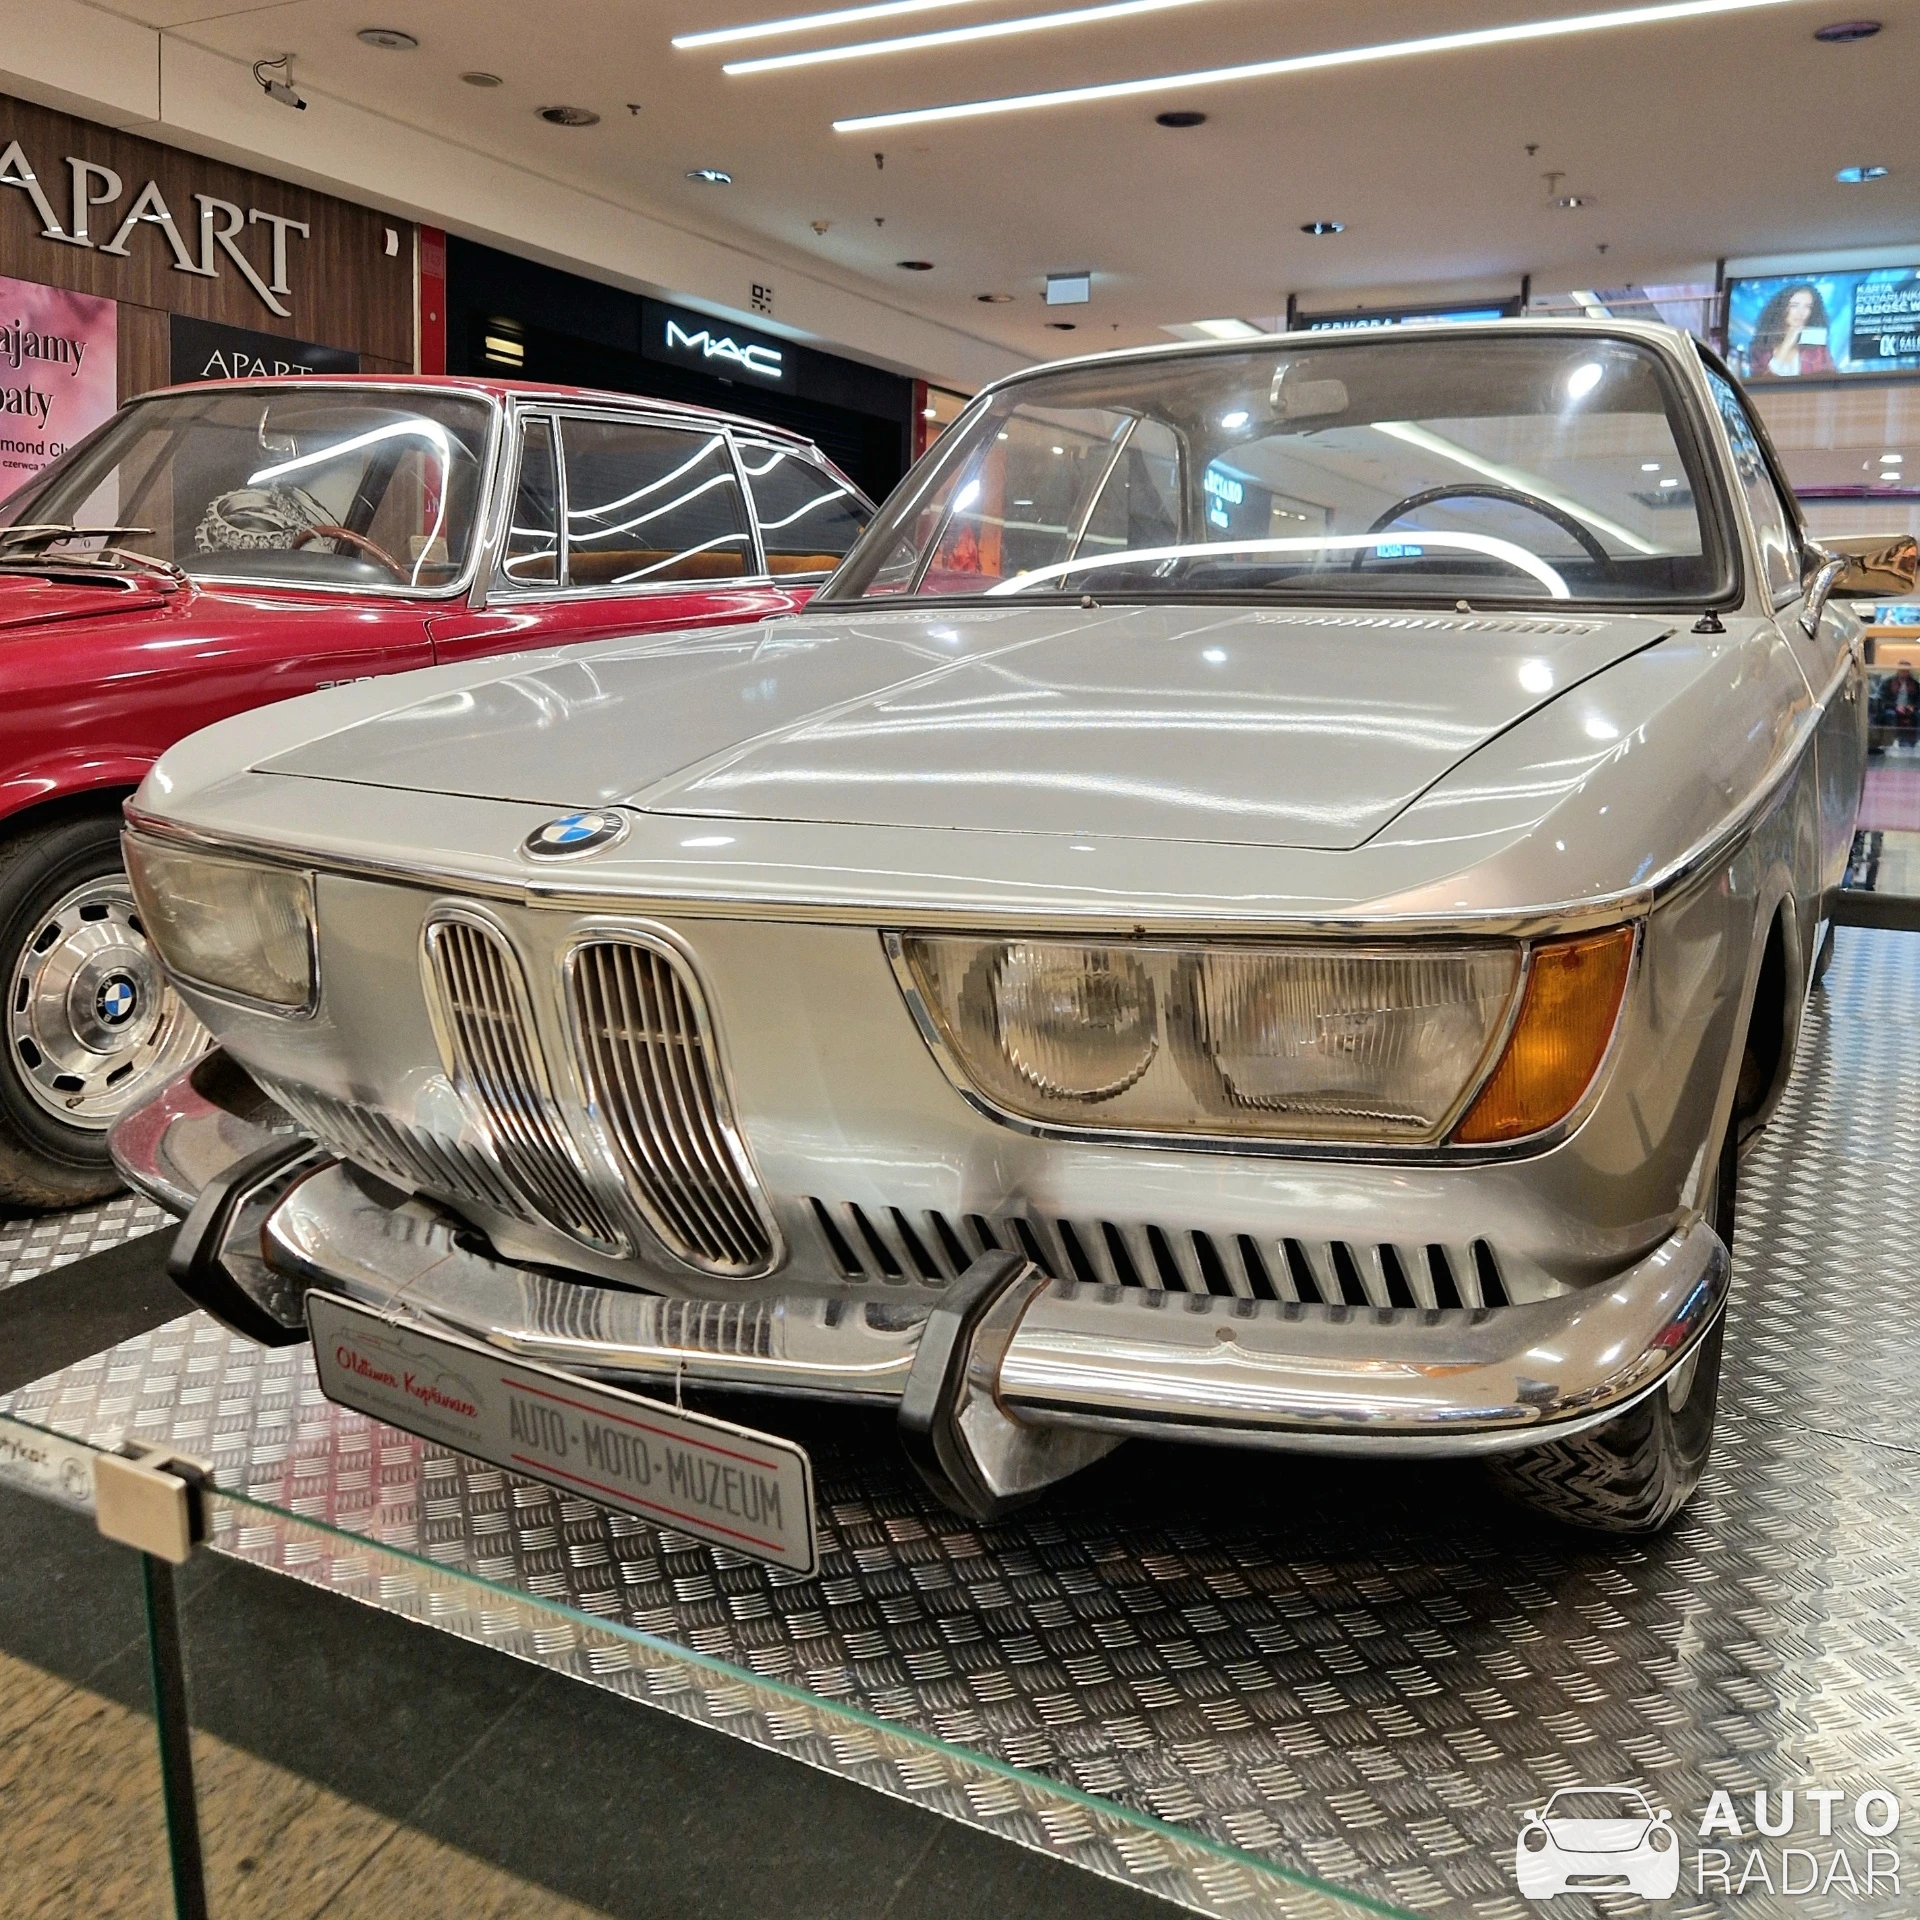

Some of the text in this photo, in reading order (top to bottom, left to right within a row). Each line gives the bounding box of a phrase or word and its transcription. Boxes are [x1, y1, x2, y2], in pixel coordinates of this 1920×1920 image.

[0, 140, 310, 317] APART
[2, 460, 39, 470] czerwca
[509, 1396, 566, 1458] AUTO
[582, 1419, 650, 1486] MOTO
[666, 1448, 783, 1530] MUZEUM
